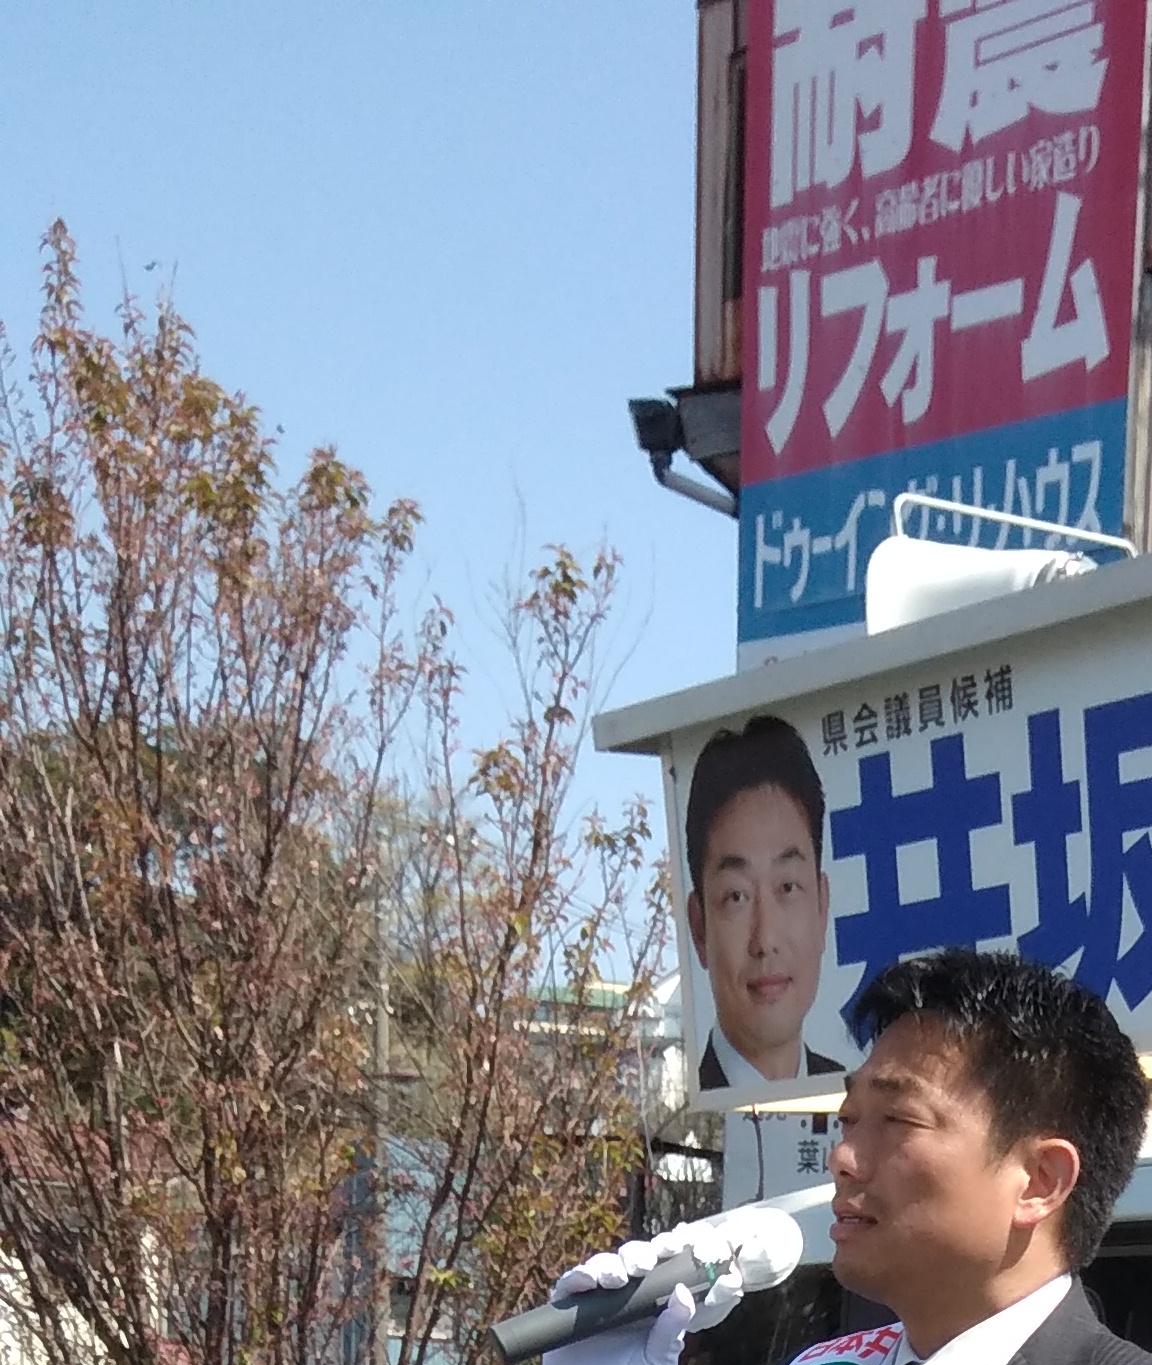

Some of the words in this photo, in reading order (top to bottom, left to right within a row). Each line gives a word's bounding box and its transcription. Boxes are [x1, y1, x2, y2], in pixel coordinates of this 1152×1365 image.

[756, 192, 1111, 455] リフォーム
[821, 664, 1013, 757] 県会議員候補
